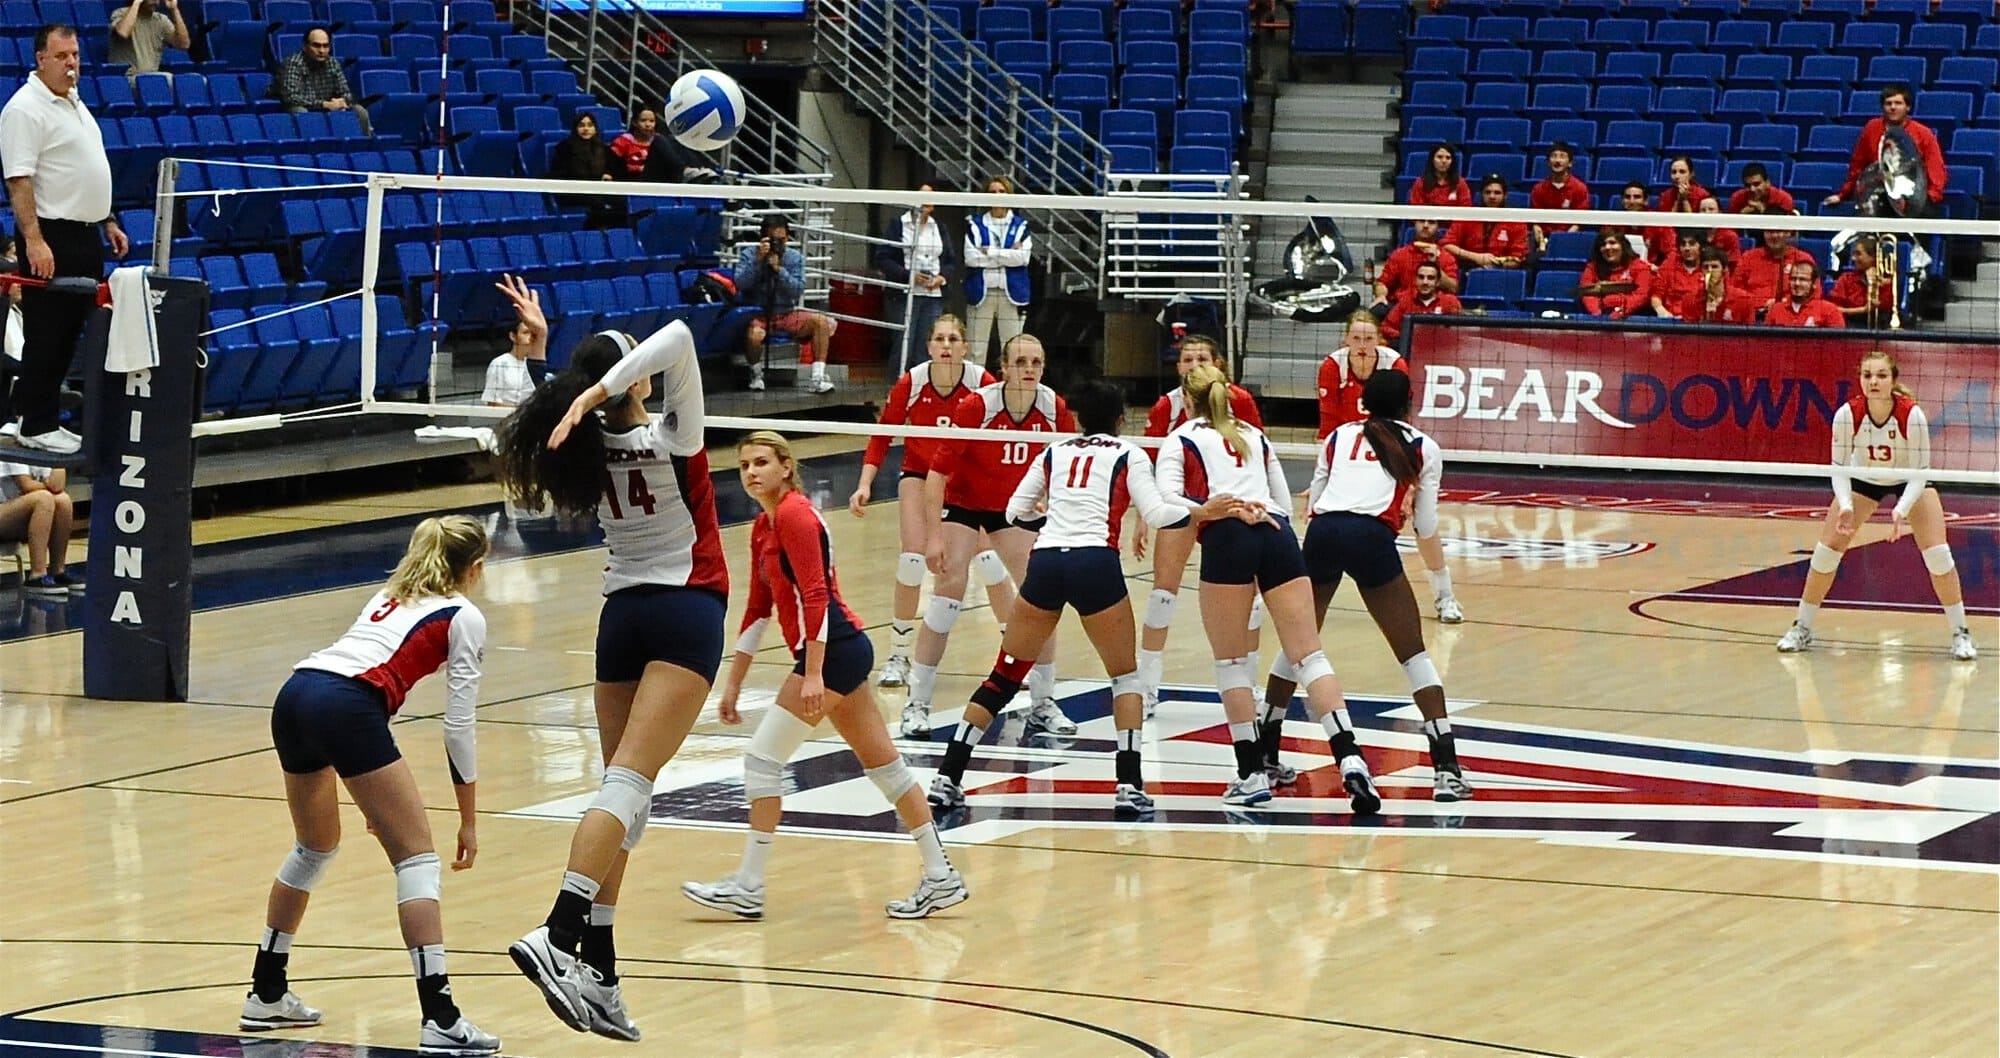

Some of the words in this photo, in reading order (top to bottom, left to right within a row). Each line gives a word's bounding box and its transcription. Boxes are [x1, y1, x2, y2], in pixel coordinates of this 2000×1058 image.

[1418, 364, 1637, 429] BEAR
[1619, 372, 1854, 432] DOWN
[1001, 443, 1029, 464] 10
[1066, 455, 1095, 488] 11
[1866, 444, 1893, 462] 13
[109, 368, 152, 625] RIZONA
[606, 468, 657, 520] 14
